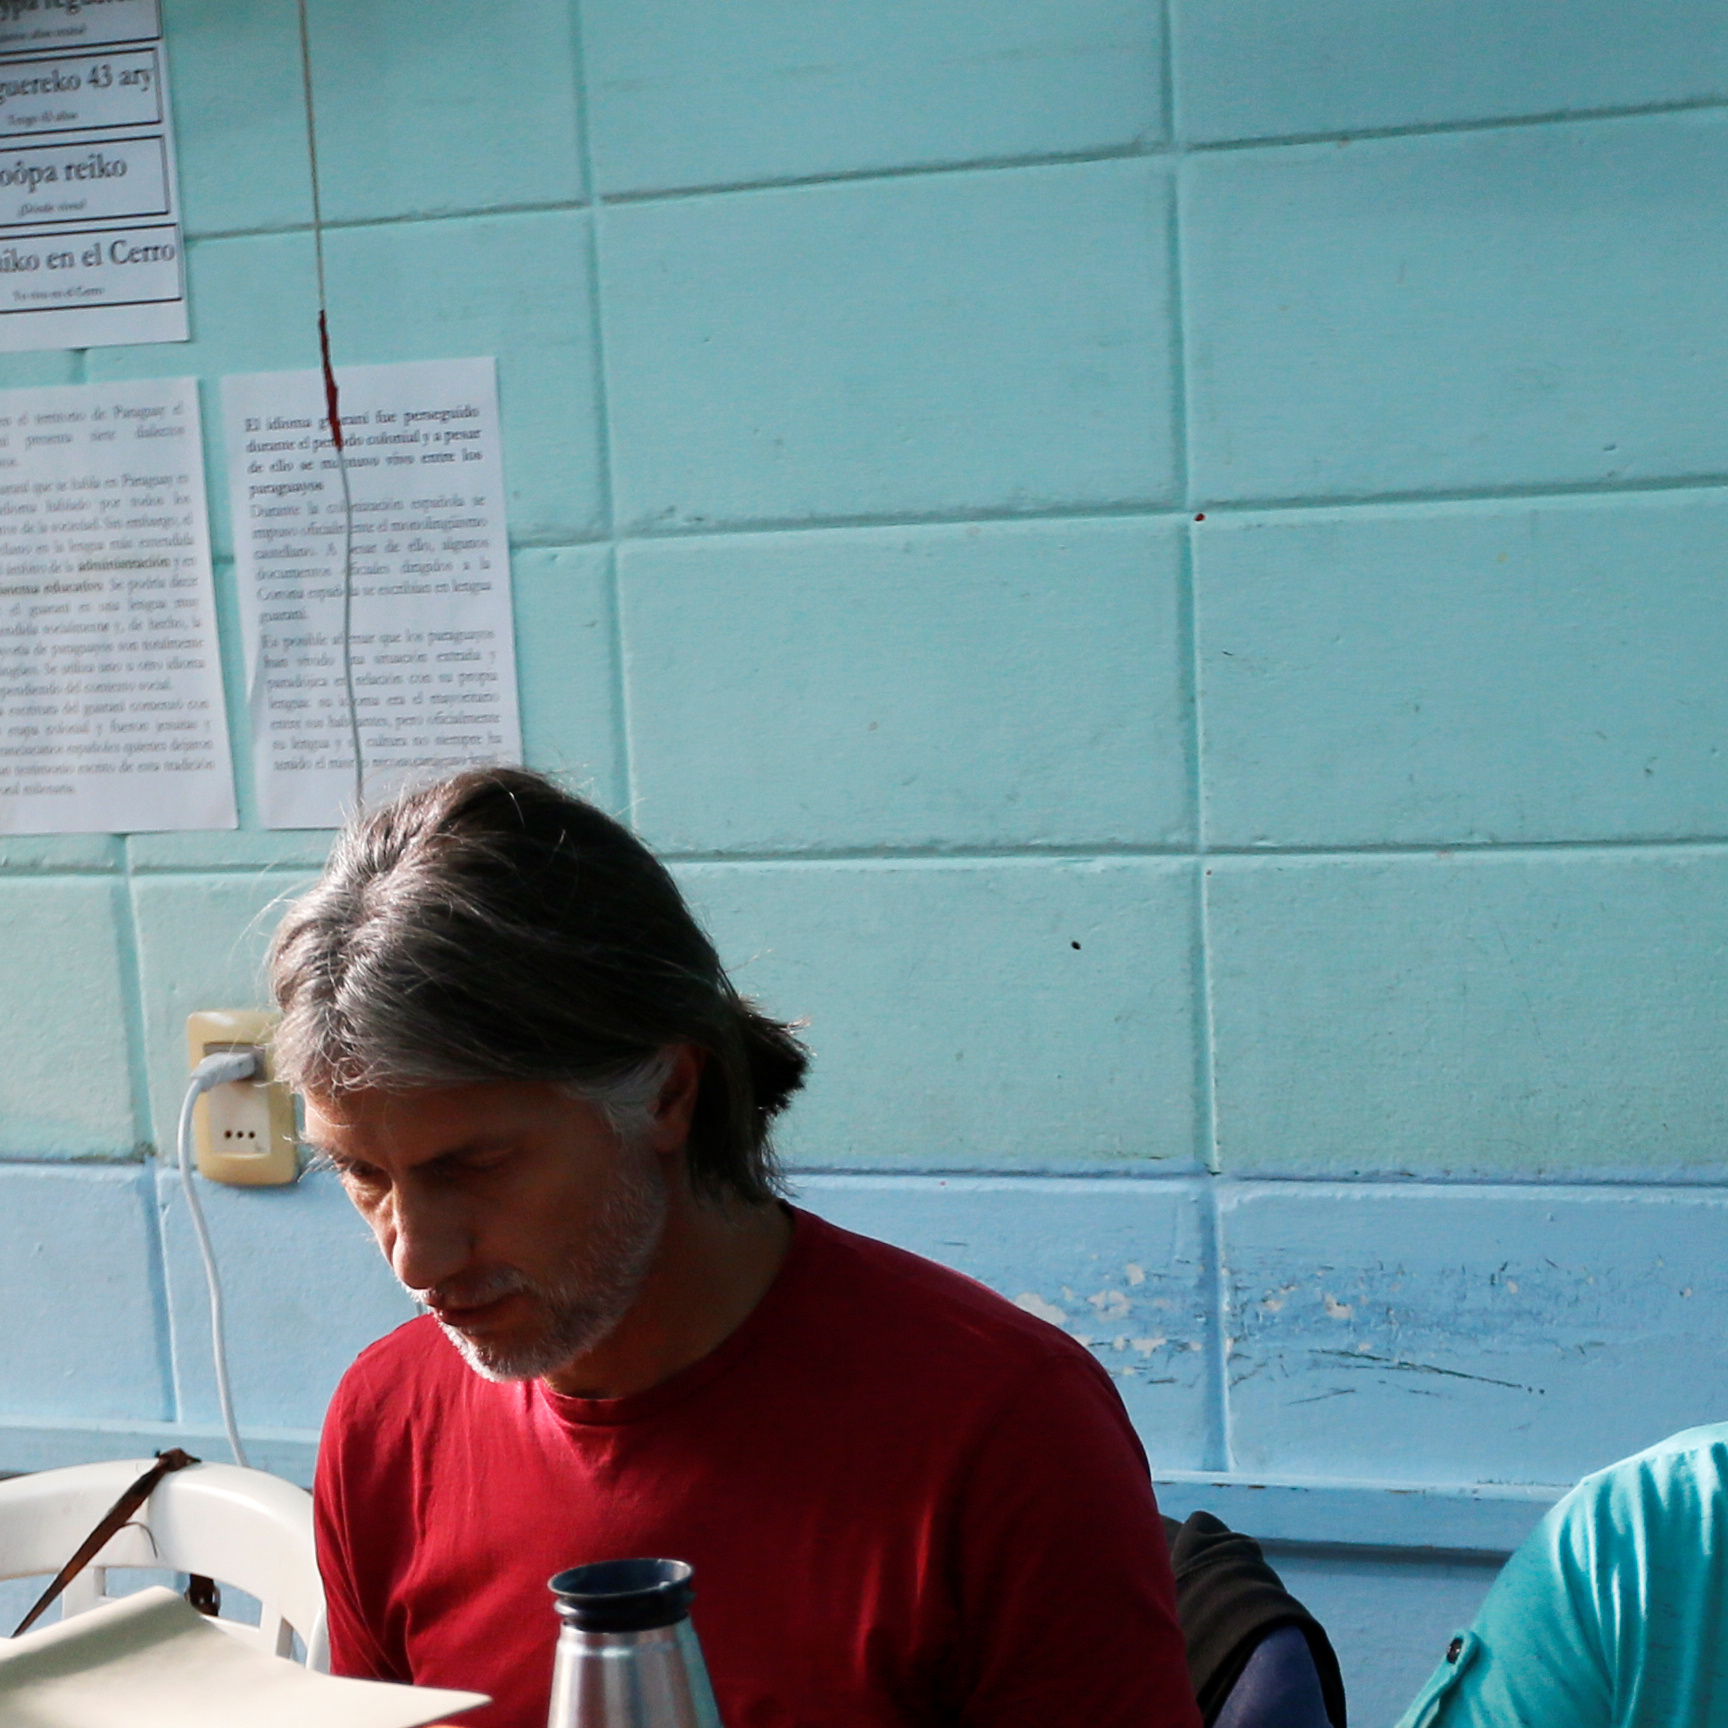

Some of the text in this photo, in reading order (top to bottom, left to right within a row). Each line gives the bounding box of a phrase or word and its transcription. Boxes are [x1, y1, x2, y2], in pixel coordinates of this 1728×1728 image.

[87, 64, 113, 89] 43
[119, 67, 153, 92] ary
[45, 251, 75, 270] en
[81, 242, 103, 267] el
[110, 238, 176, 266] Cerro
